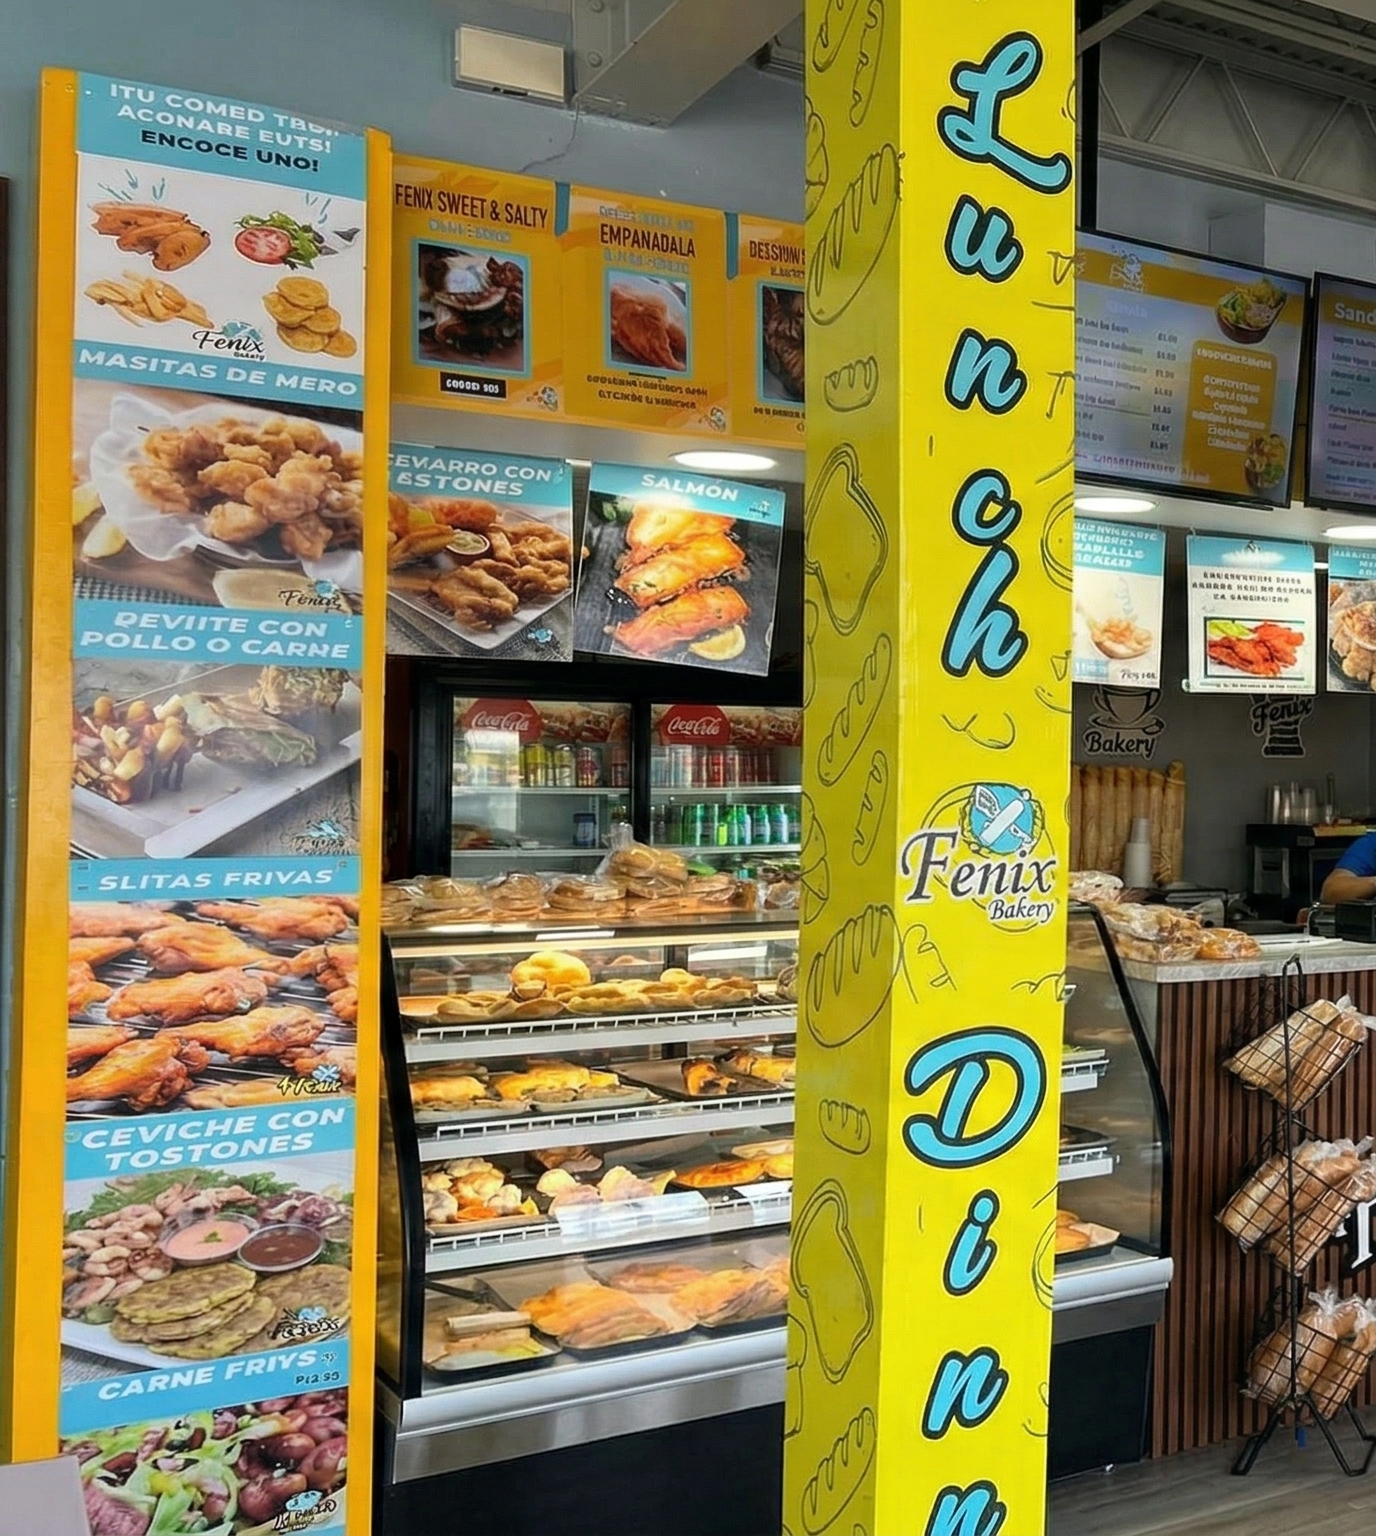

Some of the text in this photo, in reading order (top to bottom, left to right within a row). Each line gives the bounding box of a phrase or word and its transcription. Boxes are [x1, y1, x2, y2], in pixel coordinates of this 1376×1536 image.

[117, 105, 250, 139] ACONARE
[165, 93, 265, 123] COMED
[141, 130, 319, 172] ENCOCE UNO!
[395, 183, 548, 229] FENIX SWEET & SALTY
[600, 223, 696, 258] EMPANADALA
[938, 31, 1072, 678] Lunch
[79, 349, 358, 396] MASITAS DE MERO
[504, 465, 552, 482] CON
[80, 630, 350, 659] POLLO O CARNE
[258, 619, 328, 638] CON
[1253, 698, 1312, 733] Fenix
[1085, 731, 1156, 759] Bakery
[98, 869, 333, 891] SLITAS FRIVAS
[901, 830, 1057, 902] Fenix
[988, 896, 1055, 924] Bakery
[82, 1107, 345, 1150] CEVICHE CON
[105, 1133, 314, 1172] TOSTONES
[98, 1366, 214, 1401] CARNE
